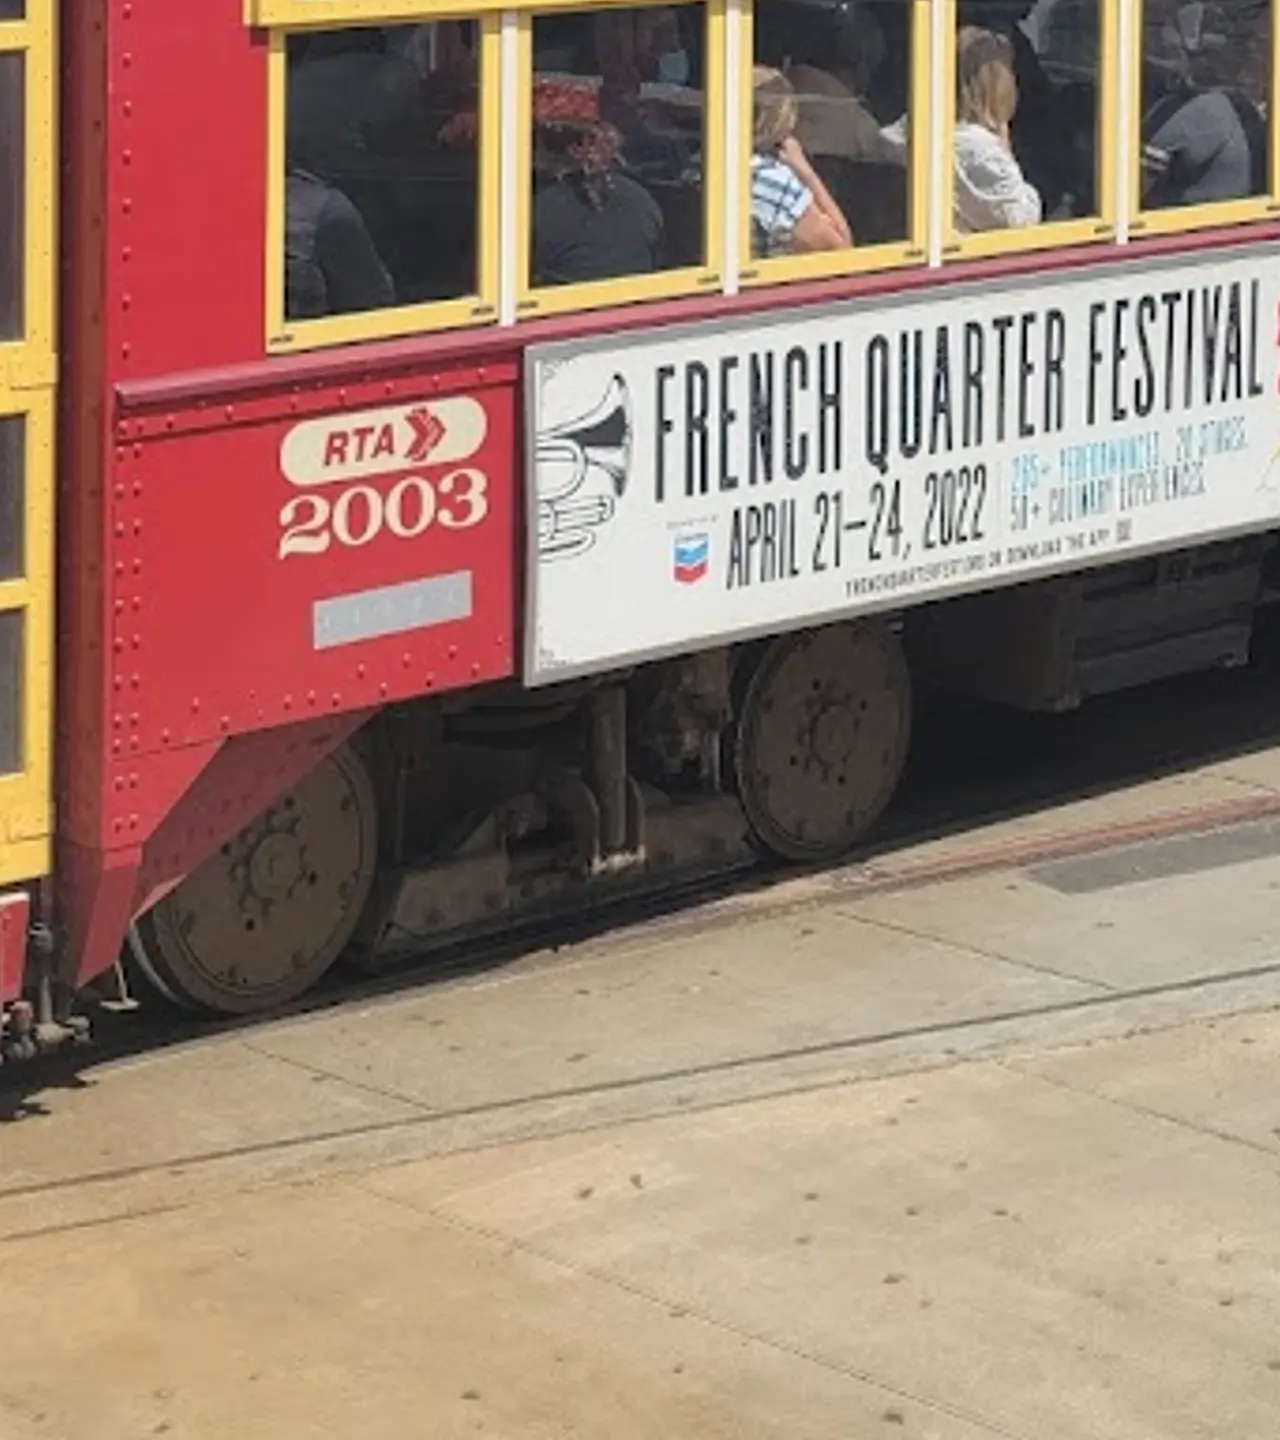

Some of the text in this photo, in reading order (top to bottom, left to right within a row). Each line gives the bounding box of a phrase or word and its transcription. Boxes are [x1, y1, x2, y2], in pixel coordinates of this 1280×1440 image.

[323, 422, 396, 466] RTA
[654, 278, 1264, 503] FRENCH QUARTER FESTIVAL
[278, 468, 489, 560] 2003
[726, 498, 800, 590] APRIL
[923, 463, 988, 549] 2022
